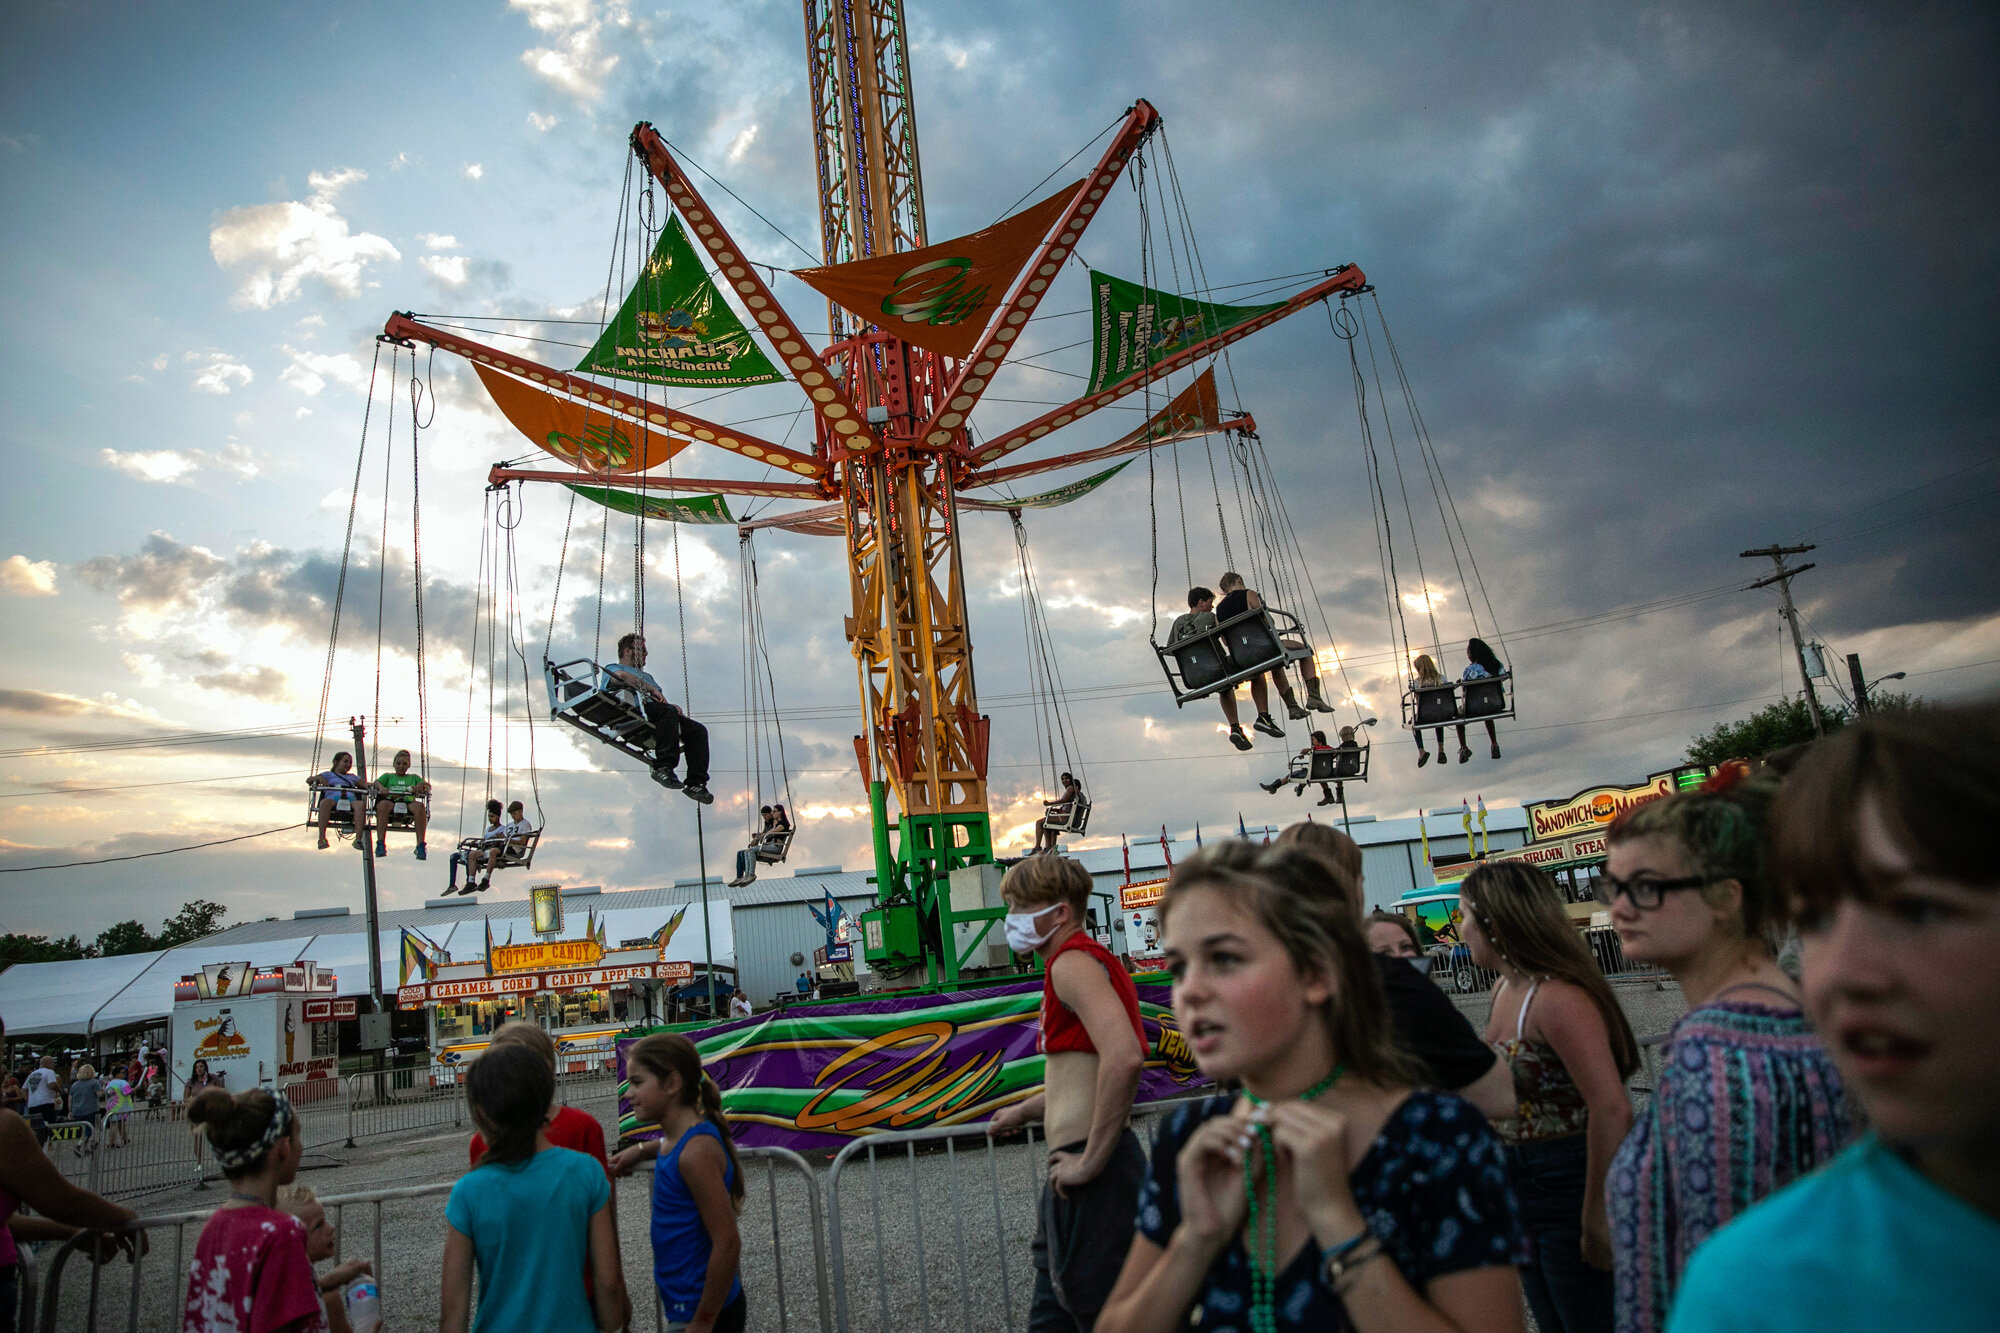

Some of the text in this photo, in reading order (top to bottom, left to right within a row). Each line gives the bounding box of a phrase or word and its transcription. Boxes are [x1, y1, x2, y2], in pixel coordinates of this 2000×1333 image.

[616, 341, 740, 360] MICHAEL'S
[1116, 311, 1133, 374] Amusements
[1534, 804, 1593, 835] SANDWICH
[1523, 846, 1564, 864] SIRLOIN
[1574, 838, 1607, 856] STEA
[499, 943, 590, 968] COTTON CANDY
[658, 970, 689, 978] DRINKS
[663, 963, 686, 971] COLD
[551, 967, 646, 987] CANDY APPLES
[403, 987, 421, 995] COLD
[437, 978, 533, 998] CARAMEL CORN
[400, 994, 424, 1002] DRINKS
